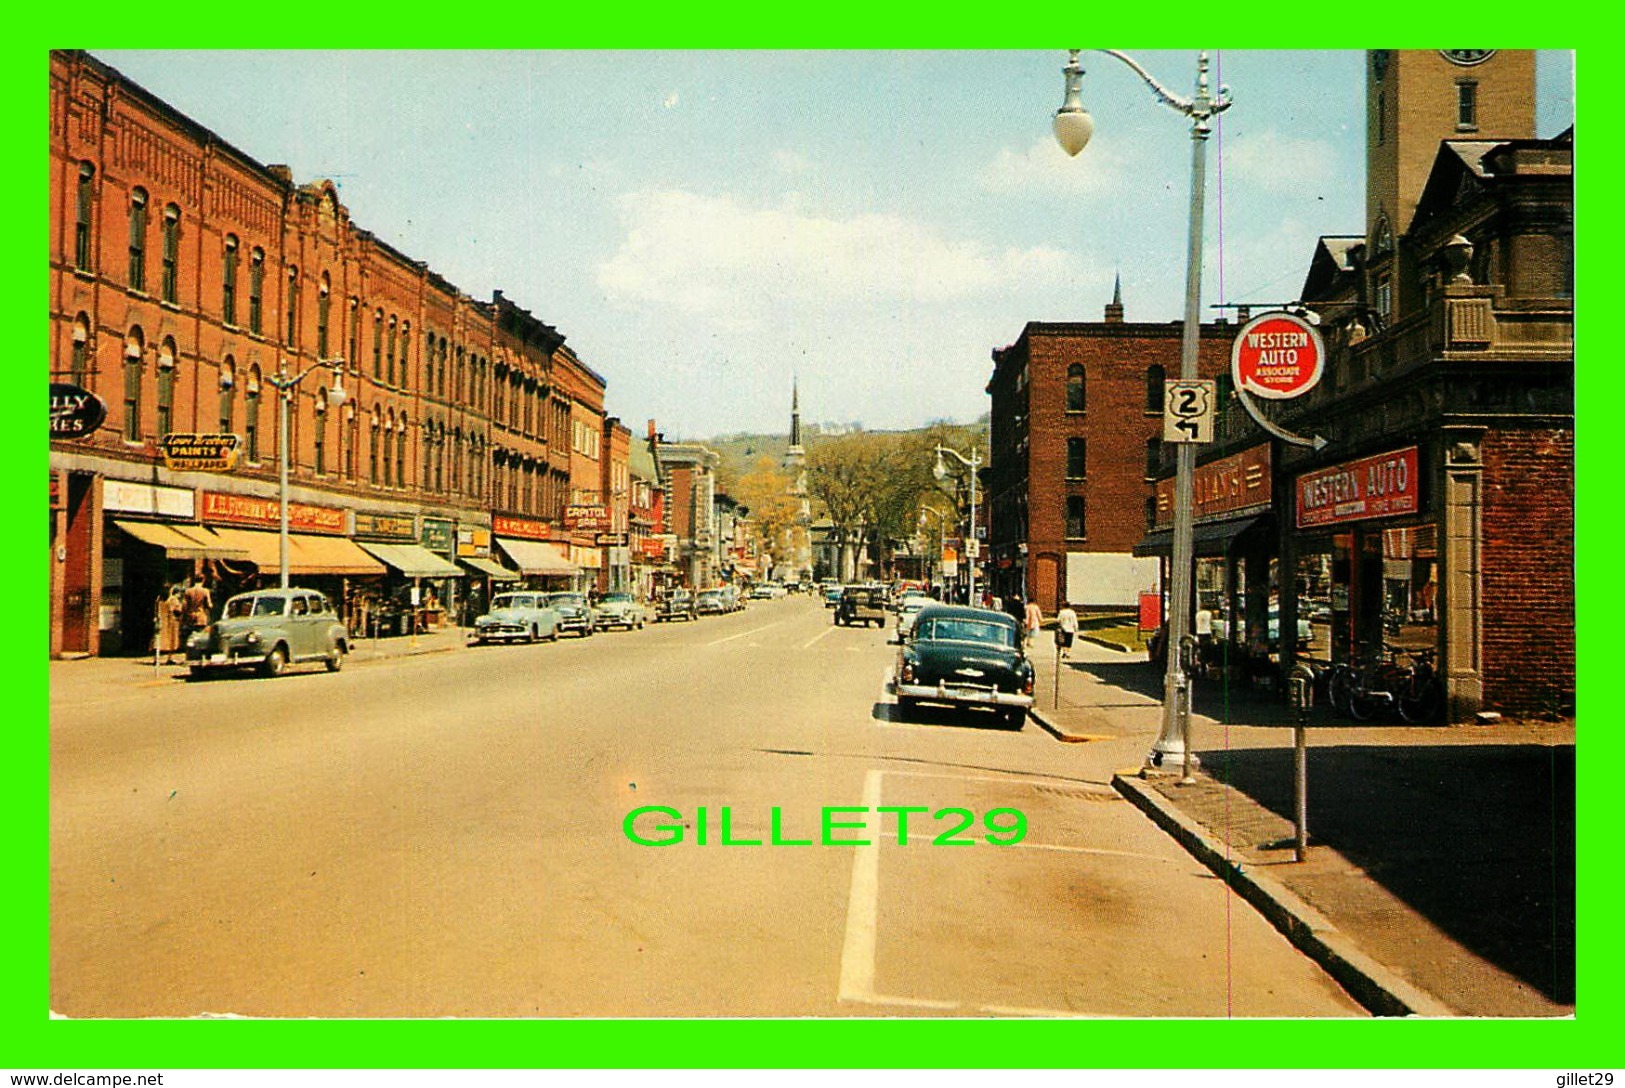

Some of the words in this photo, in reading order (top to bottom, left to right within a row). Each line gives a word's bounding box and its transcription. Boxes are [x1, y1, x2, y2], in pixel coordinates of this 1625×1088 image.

[1247, 332, 1308, 349] WESTERN
[1258, 349, 1298, 365] AUTO
[1255, 366, 1300, 377] ASSOCIATE
[1264, 376, 1294, 384] STORE
[1179, 389, 1198, 413] 2
[171, 447, 217, 456] PAINTS
[1302, 469, 1359, 509] WESTERN
[1366, 456, 1408, 497] AUTO
[566, 507, 607, 518] CAPITOL
